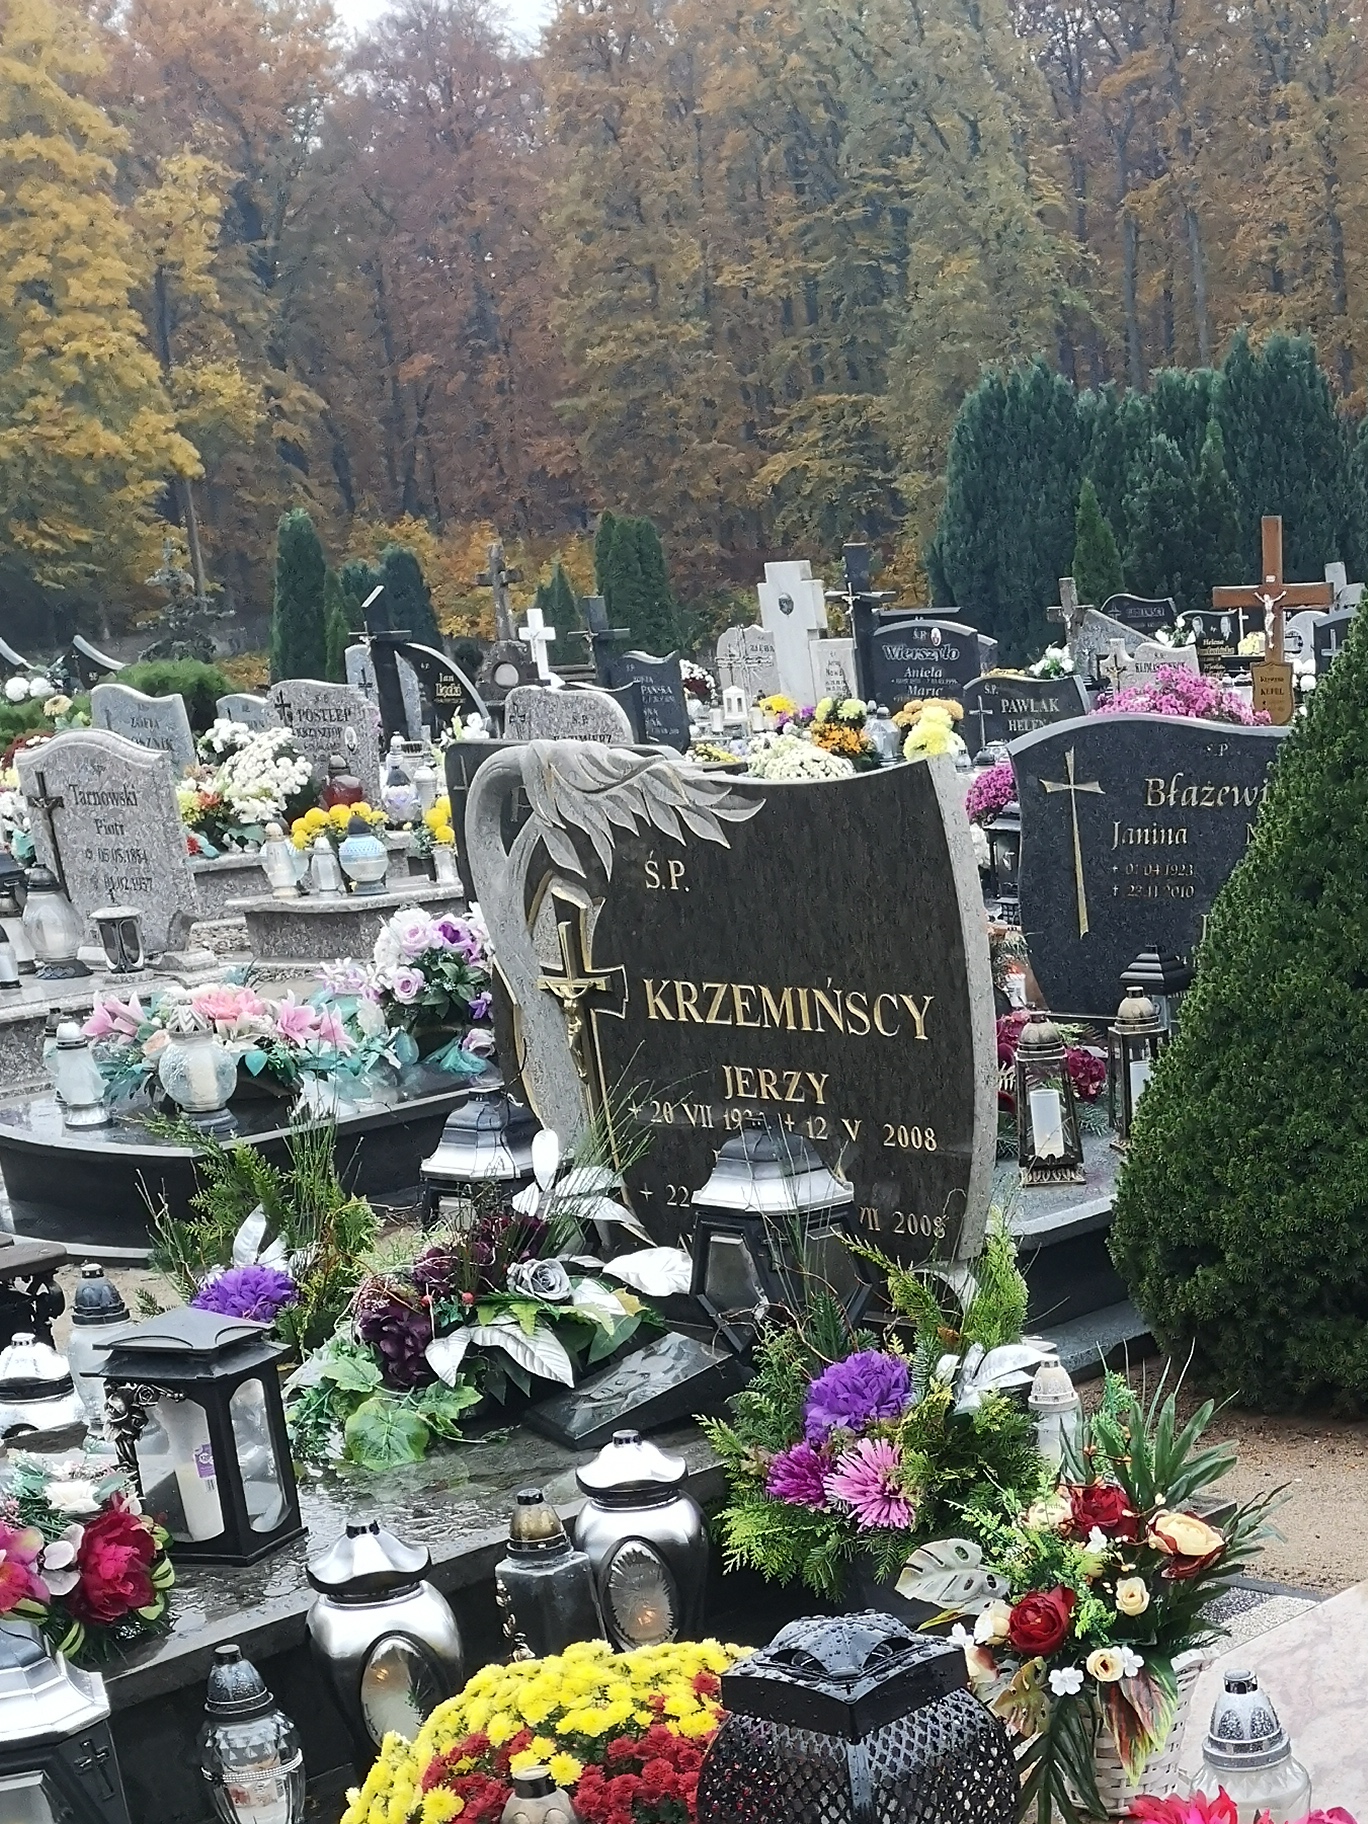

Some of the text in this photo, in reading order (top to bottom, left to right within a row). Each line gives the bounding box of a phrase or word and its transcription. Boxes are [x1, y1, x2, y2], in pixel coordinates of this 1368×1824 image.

[1001, 698, 1061, 713] PAWLAK
[1008, 718, 1052, 732] HELEN
[69, 784, 138, 806] Tarnowski
[94, 818, 125, 836] Piotr
[1111, 821, 1188, 850] Janina
[643, 850, 690, 892] Ś.P.
[642, 976, 935, 1041] KRZEMIŃSCY
[722, 1064, 829, 1105] JERZY
[650, 1100, 676, 1125] 20
[681, 1103, 715, 1130] VII
[805, 1115, 829, 1141] 12
[840, 1117, 863, 1143] V
[882, 1123, 938, 1151] 2008
[891, 1210, 947, 1239] 2008
